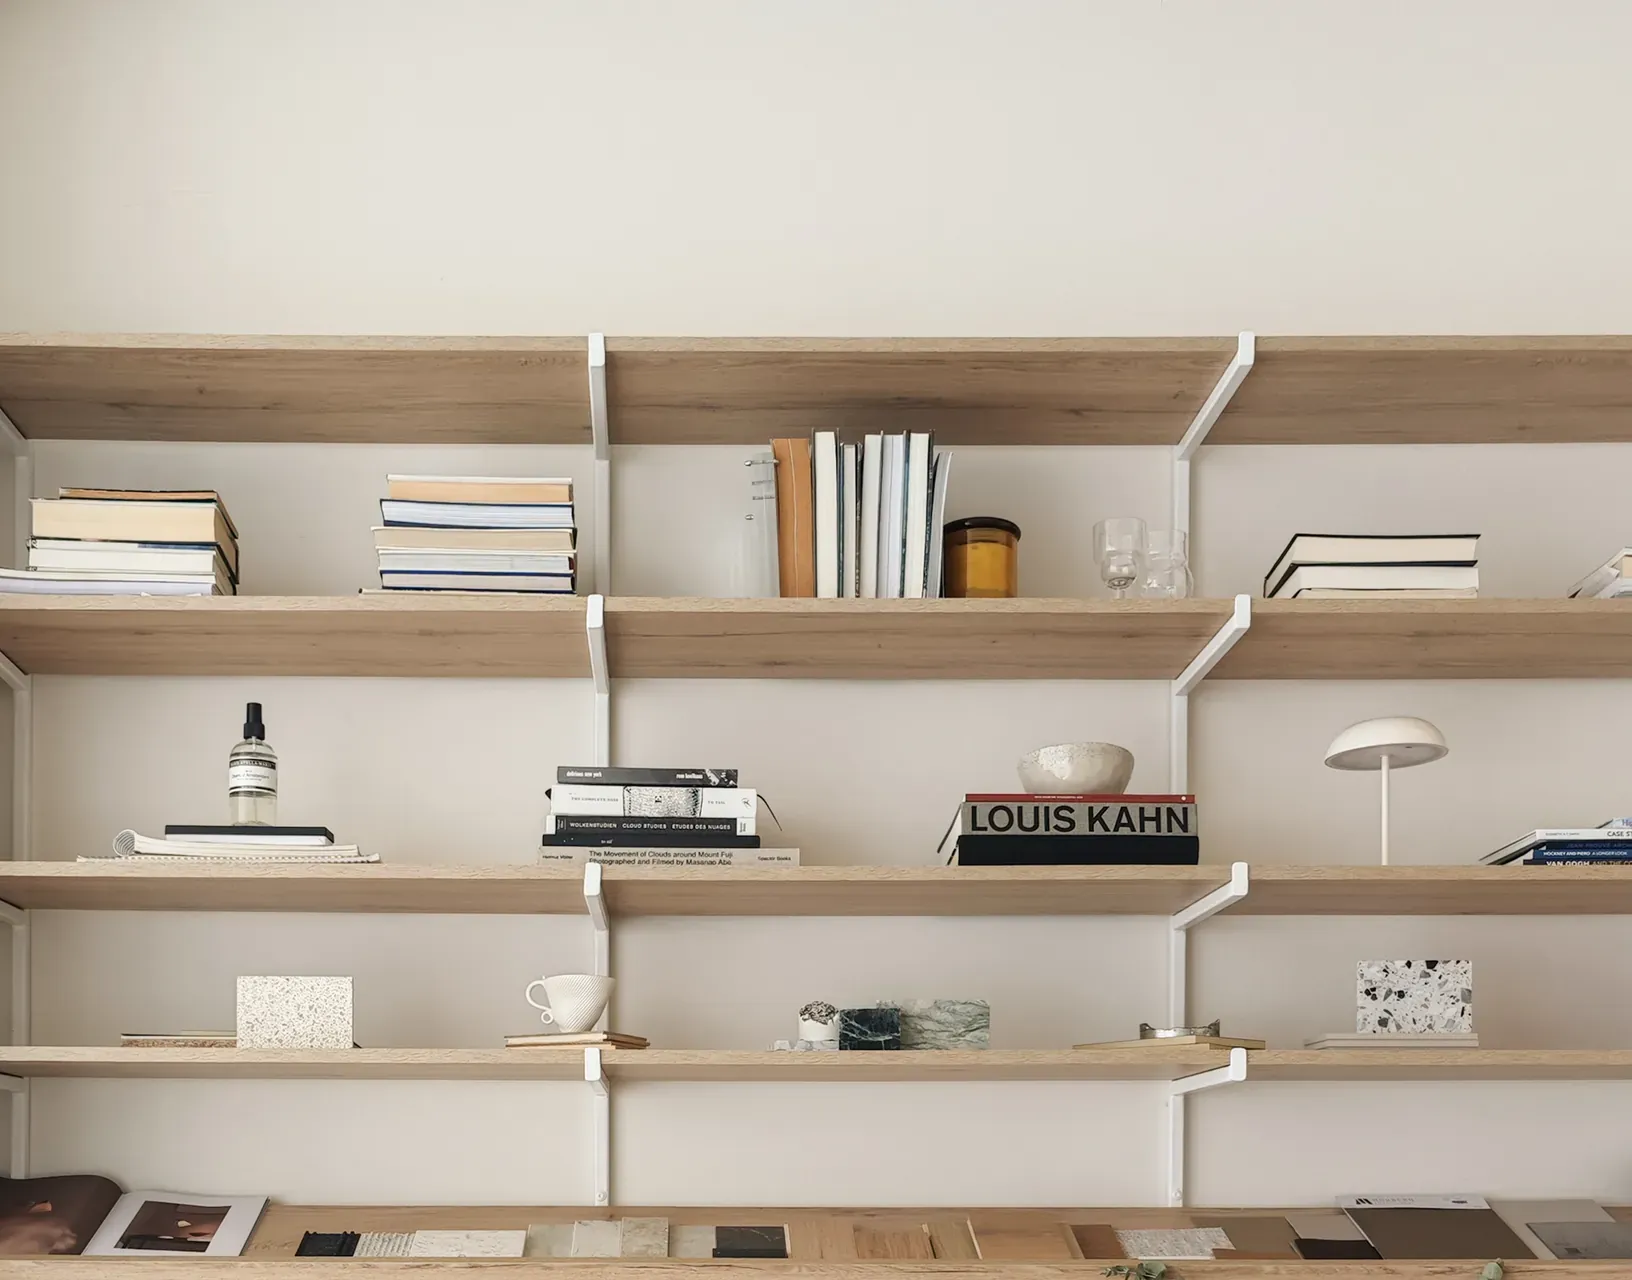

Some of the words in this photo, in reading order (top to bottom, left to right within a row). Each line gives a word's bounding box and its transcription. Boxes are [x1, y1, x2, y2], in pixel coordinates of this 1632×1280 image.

[971, 805, 1076, 833] LOUIS
[1088, 805, 1189, 834] KAHN
[643, 822, 667, 830] STUDIES
[589, 850, 603, 858] The
[603, 850, 639, 859] Movement
[639, 851, 647, 859] of
[647, 851, 671, 859] Clouds
[671, 850, 697, 859] around
[698, 850, 720, 859] Mount
[720, 850, 734, 860] Fuji
[589, 858, 636, 867] Photographed
[637, 858, 651, 866] and
[651, 858, 674, 866] Filmed
[676, 858, 684, 868] by
[686, 858, 717, 866] Masanao
[718, 858, 732, 866] Abe
